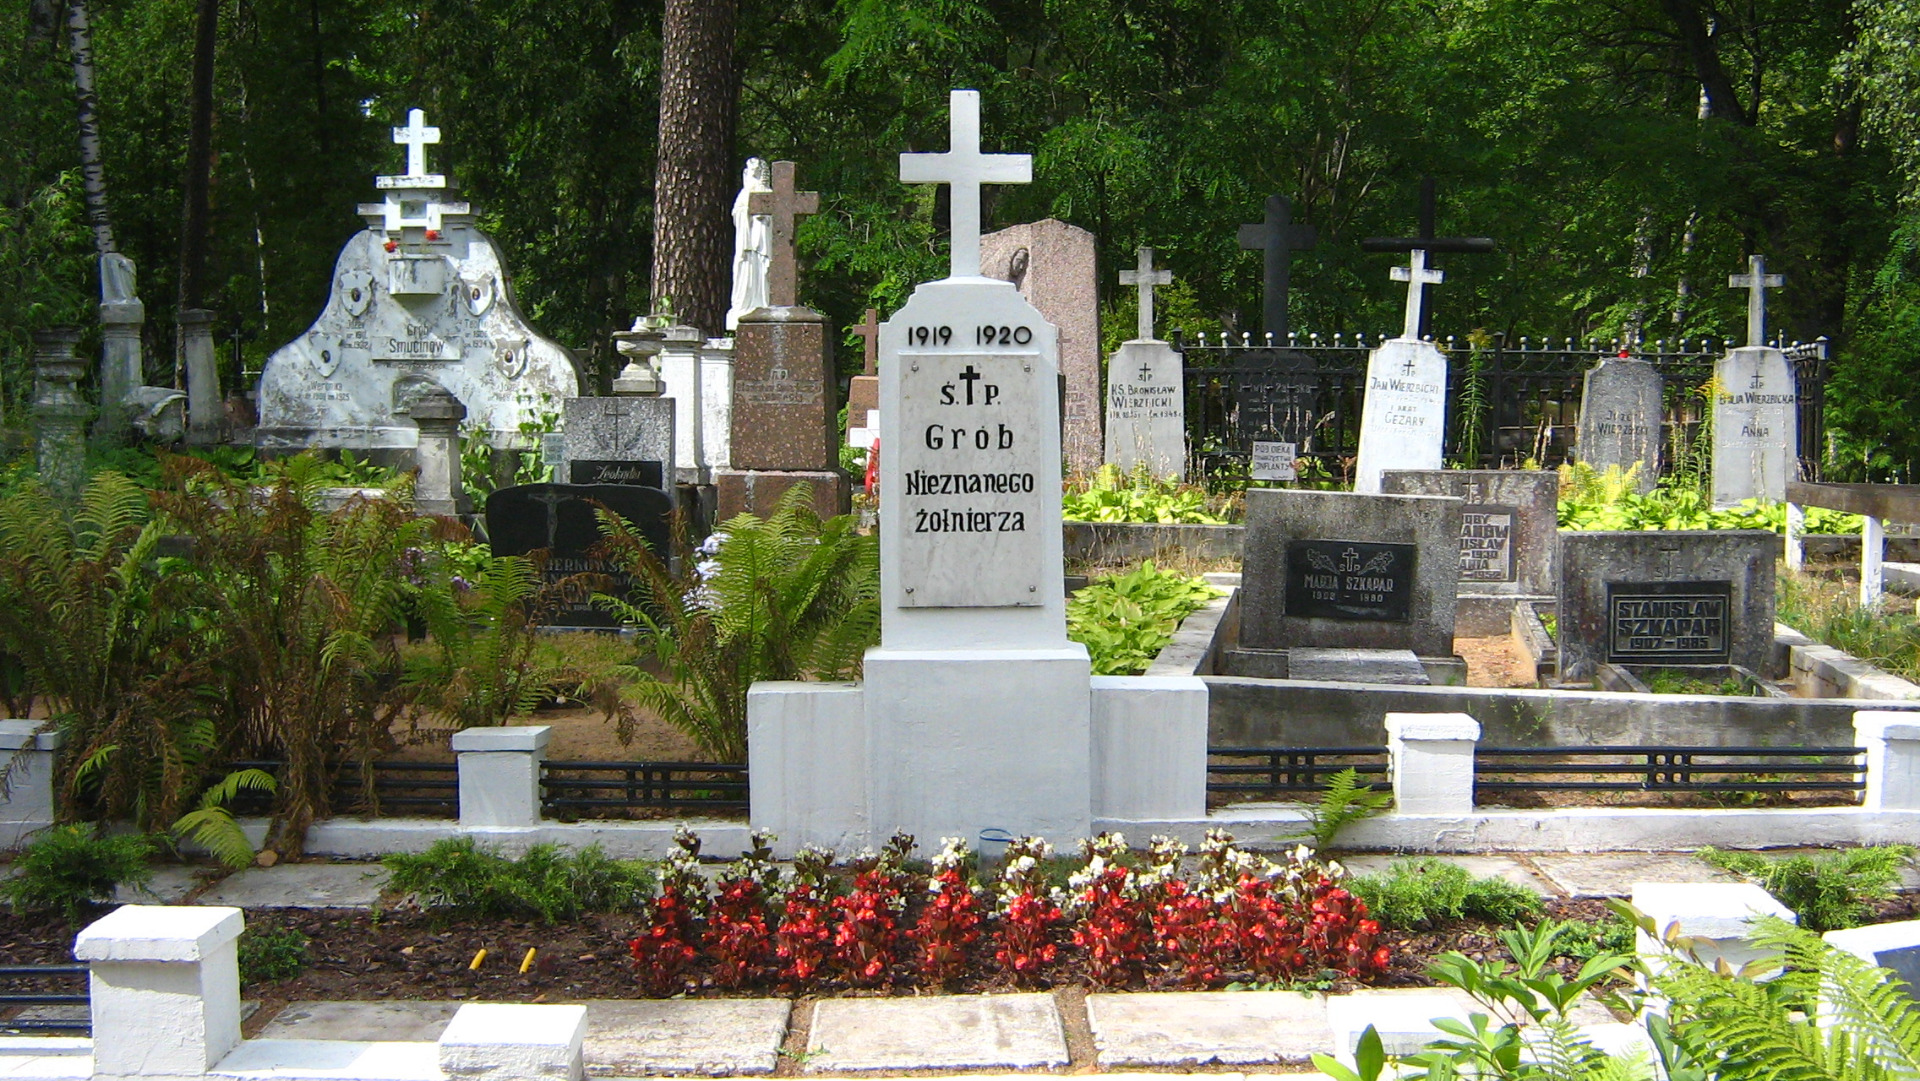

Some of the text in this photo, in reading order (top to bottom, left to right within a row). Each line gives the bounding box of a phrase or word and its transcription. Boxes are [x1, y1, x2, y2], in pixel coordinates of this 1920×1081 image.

[908, 325, 1033, 346] 1919 1920
[1370, 376, 1388, 391] JAN
[1384, 411, 1426, 426] CEZARY
[925, 424, 1014, 450] Grób
[905, 470, 1034, 496] Nieznanego
[1346, 576, 1394, 592] SZKAPAR
[1618, 619, 1721, 636] SZKAPAR
